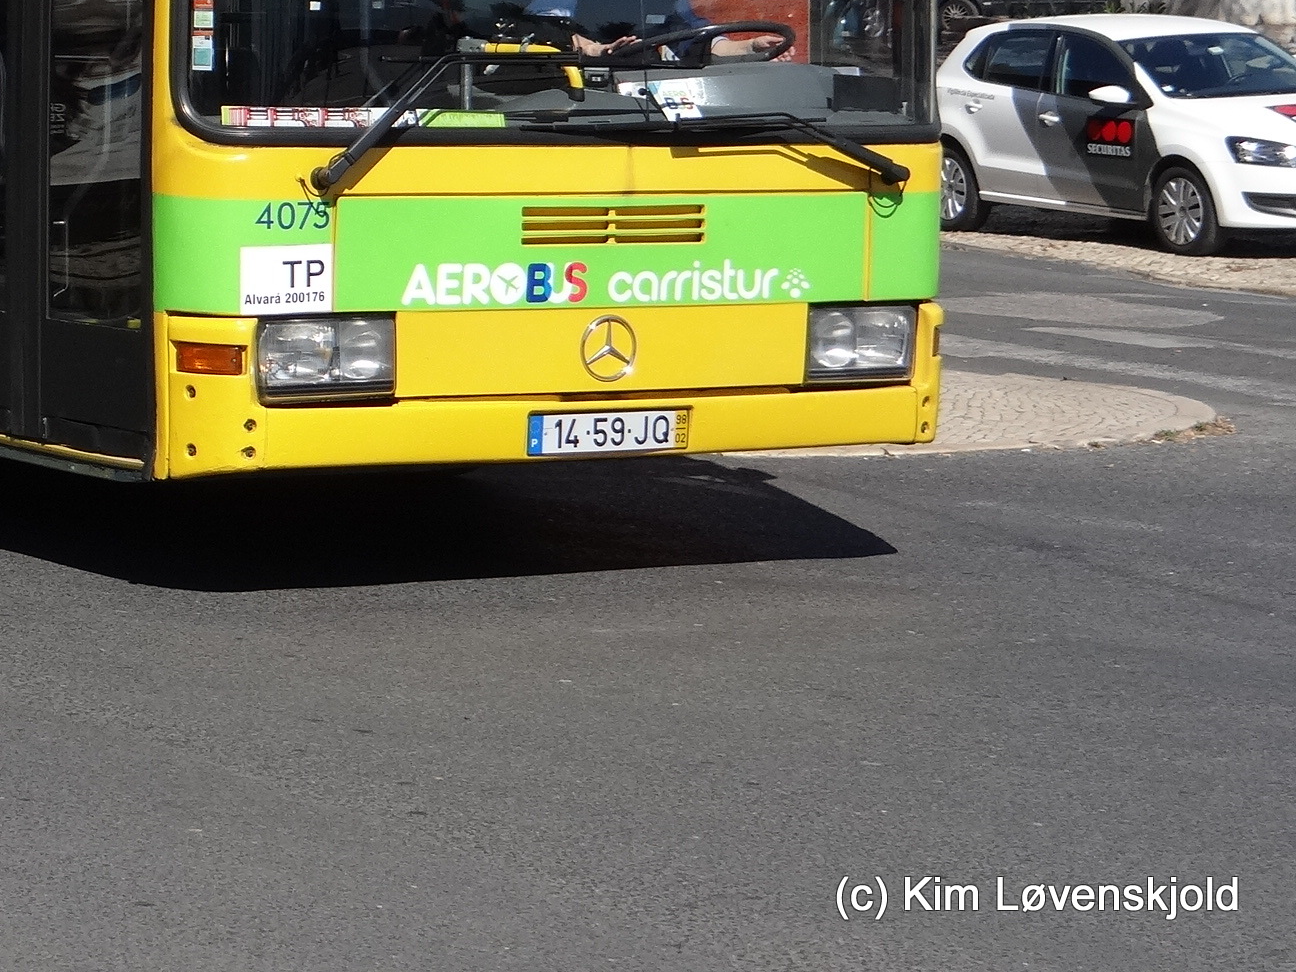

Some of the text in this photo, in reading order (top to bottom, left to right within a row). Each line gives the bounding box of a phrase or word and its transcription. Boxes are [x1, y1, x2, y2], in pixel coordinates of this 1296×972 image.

[1087, 143, 1132, 157] SECURITAS
[255, 202, 330, 230] 4075
[282, 260, 325, 288] TP
[402, 259, 778, 305] AEROBUS carristur
[244, 291, 325, 305] Alvará 200176
[531, 438, 539, 448] P
[675, 433, 686, 443] 02
